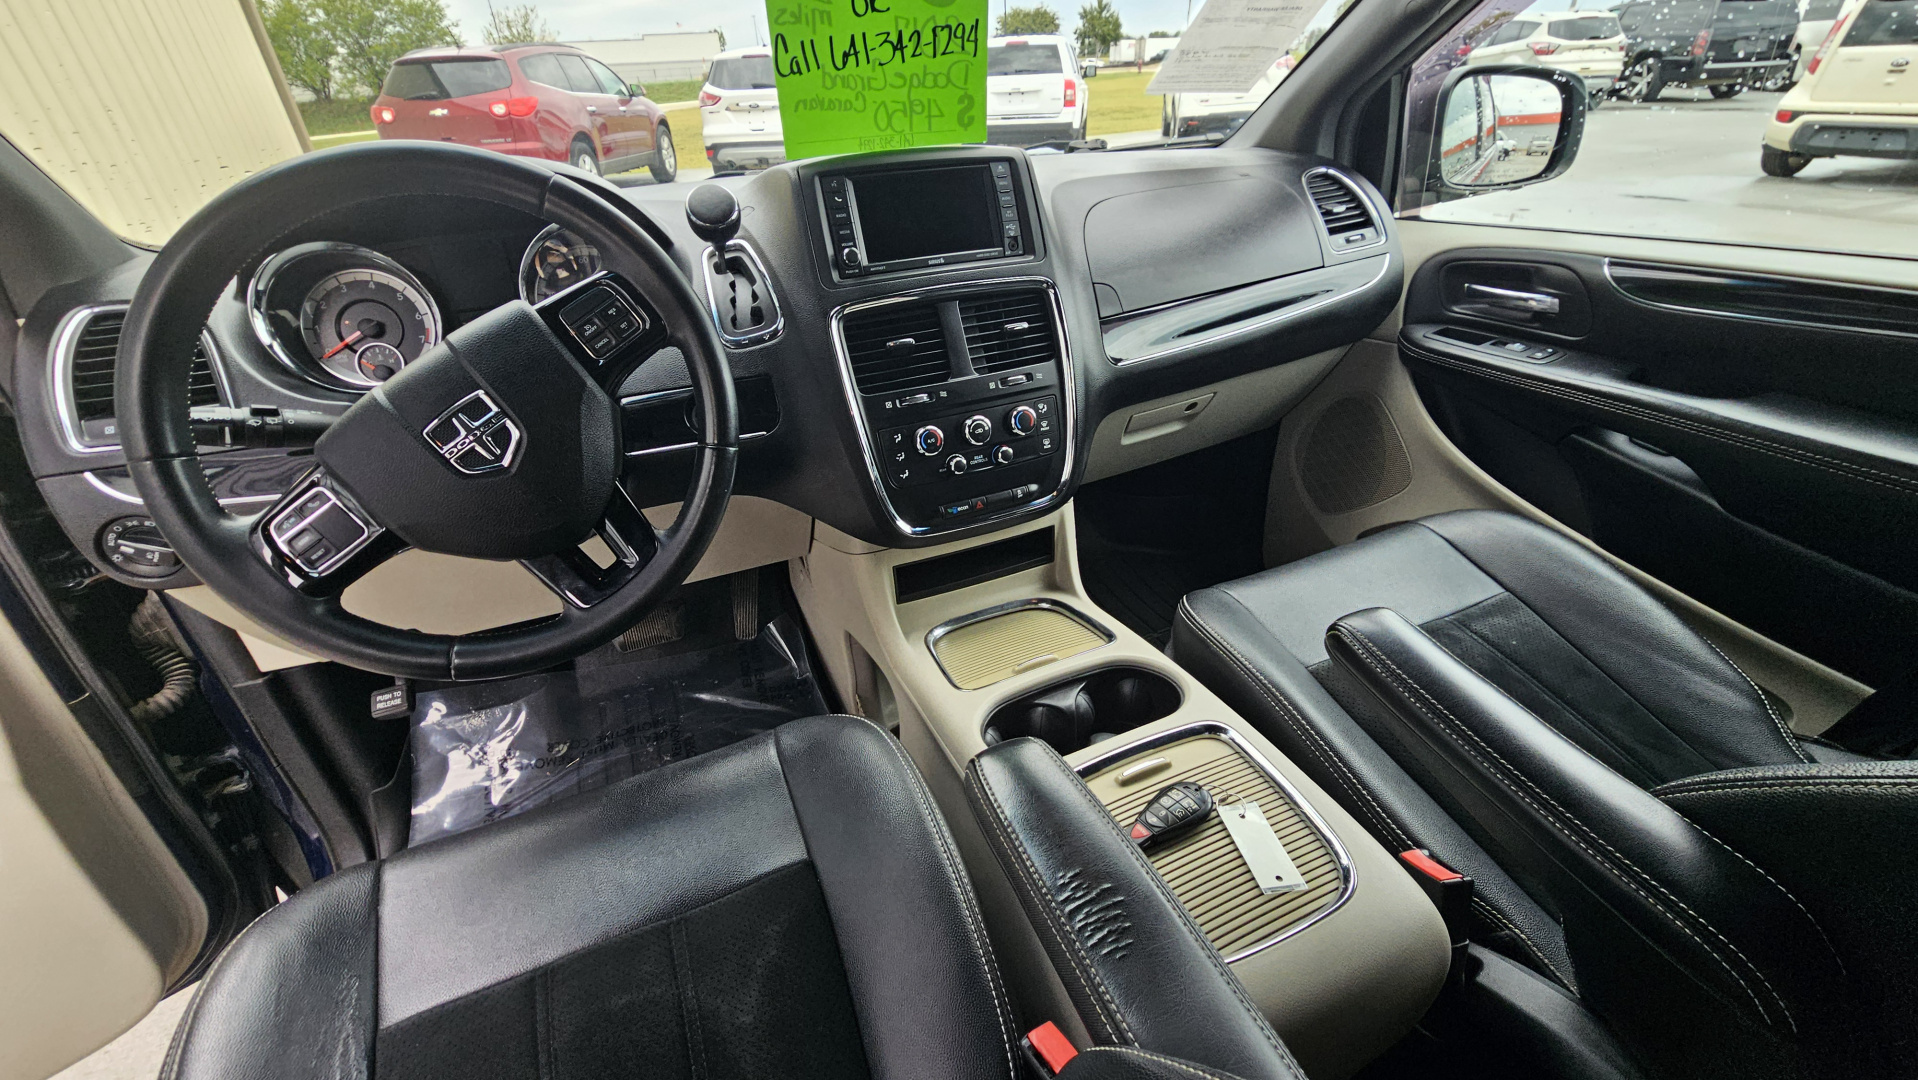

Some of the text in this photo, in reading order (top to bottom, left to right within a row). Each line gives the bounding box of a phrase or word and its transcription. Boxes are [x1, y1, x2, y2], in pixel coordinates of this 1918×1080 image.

[774, 33, 821, 78] Call
[340, 285, 347, 293] 3
[369, 281, 375, 289] 4
[320, 301, 327, 309] 2
[376, 693, 392, 702] PUSH
[376, 698, 402, 709] RELEASE
